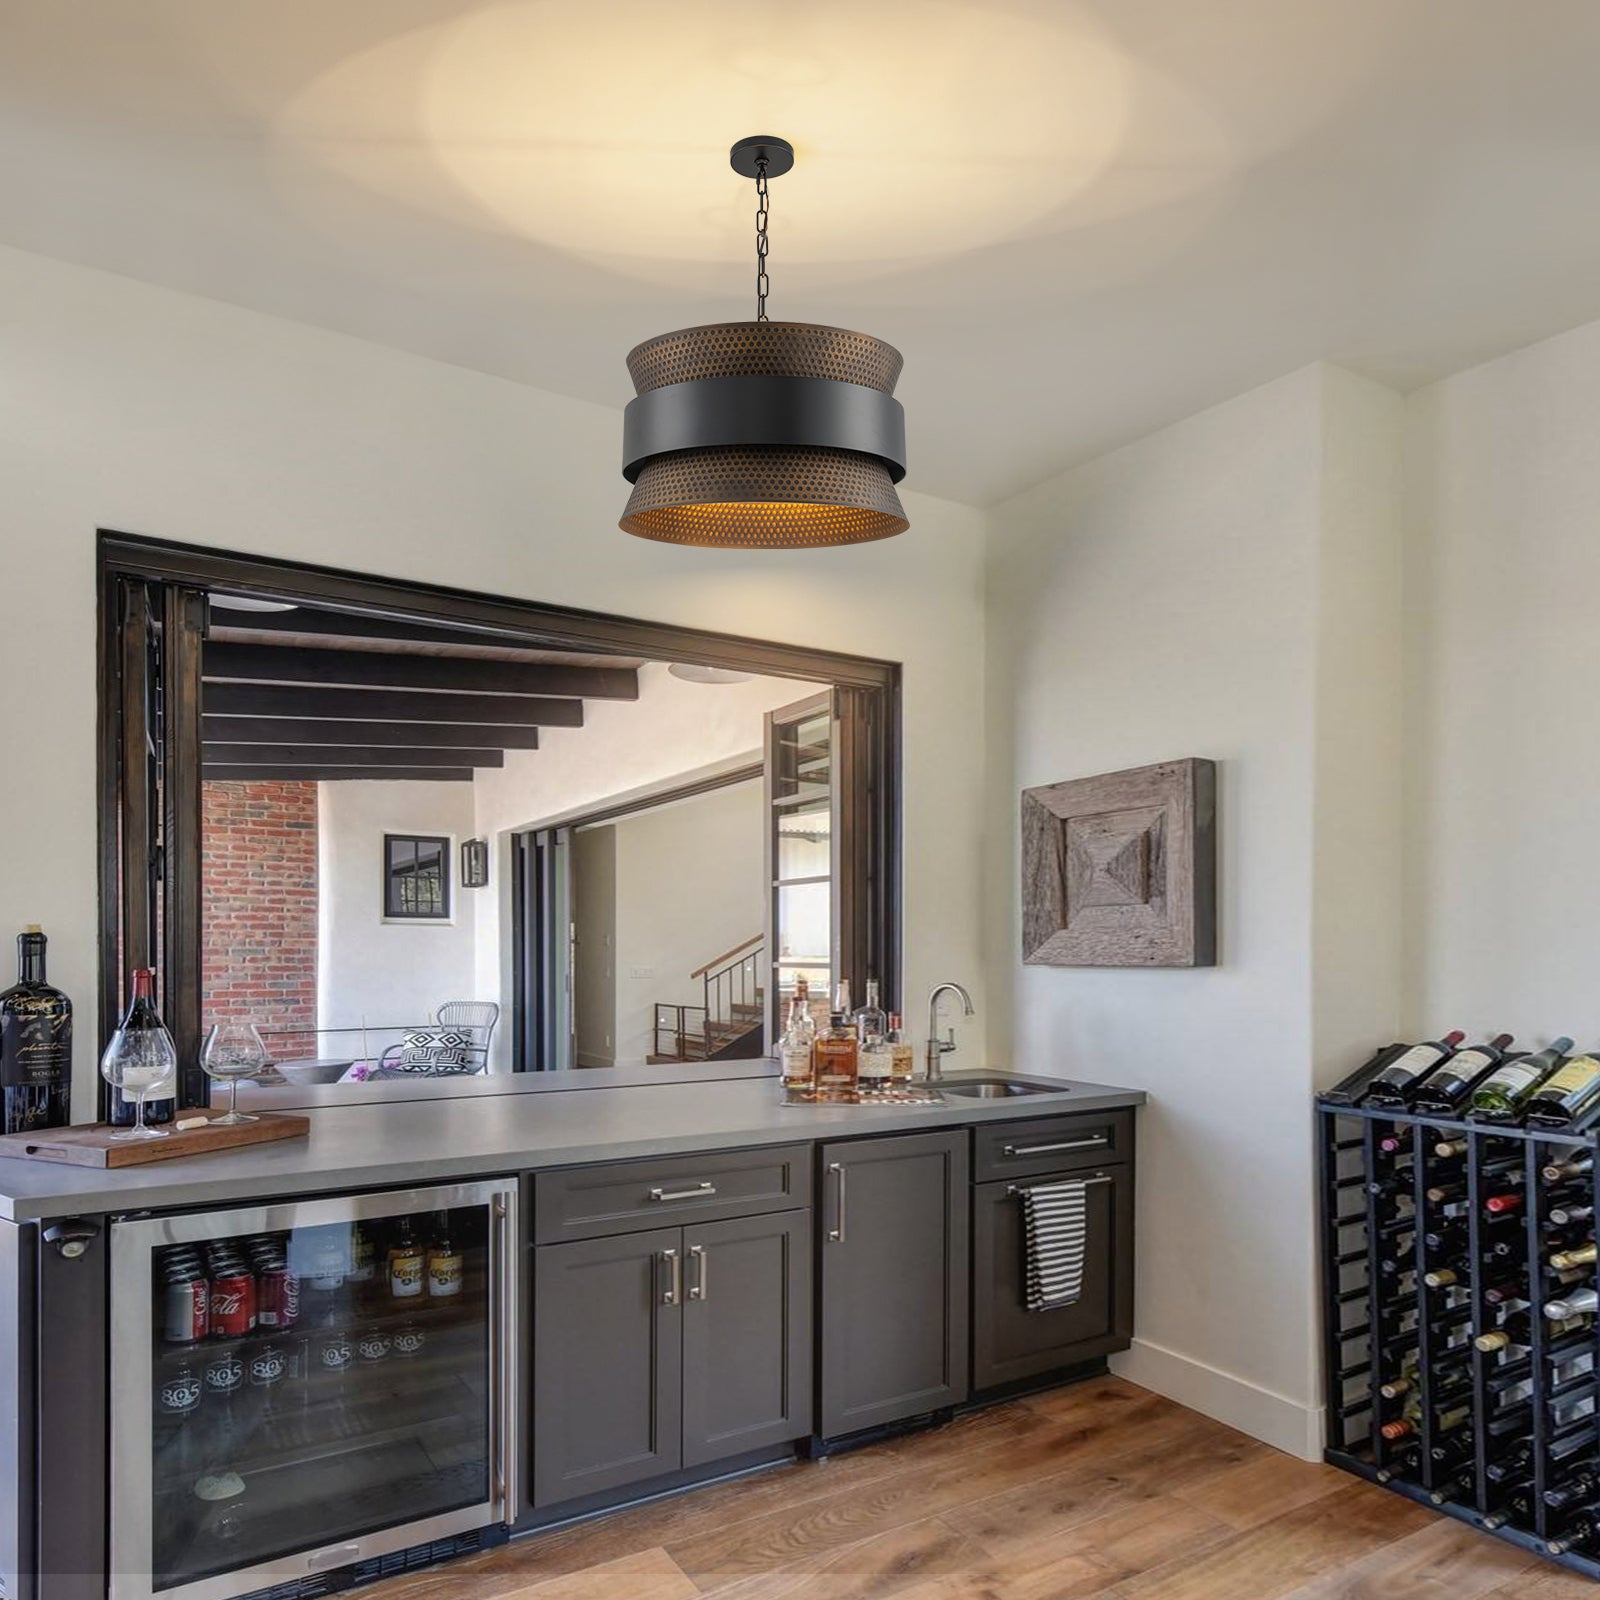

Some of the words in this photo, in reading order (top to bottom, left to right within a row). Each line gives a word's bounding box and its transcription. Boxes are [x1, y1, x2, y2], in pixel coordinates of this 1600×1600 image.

[322, 1347, 350, 1364] 05
[205, 1364, 242, 1385] 805
[161, 1383, 199, 1407] 805
